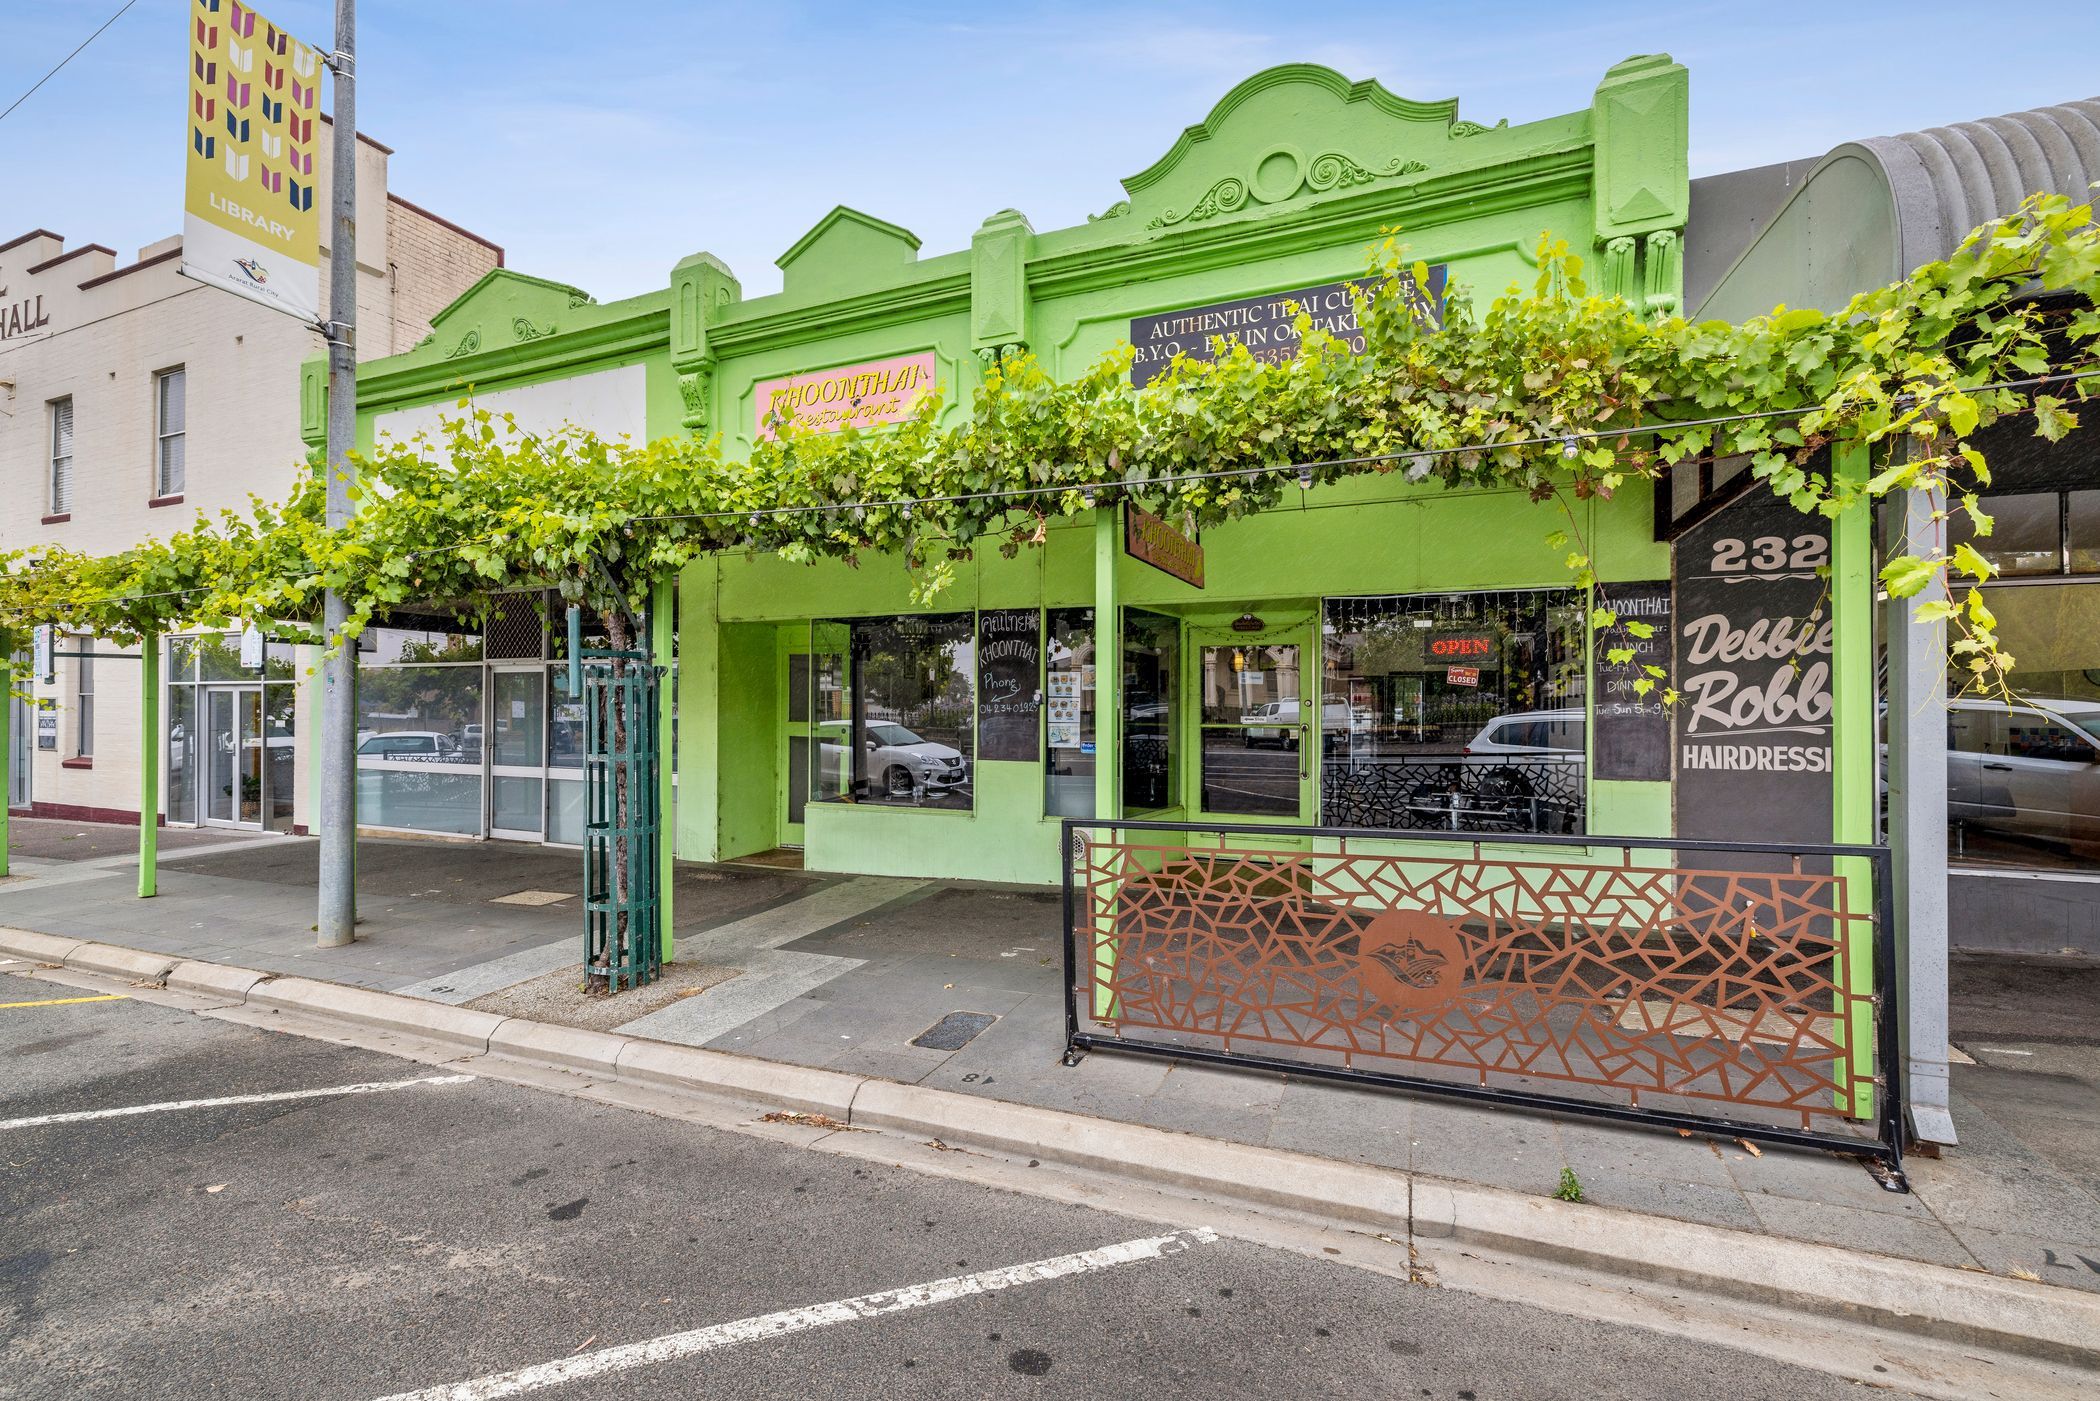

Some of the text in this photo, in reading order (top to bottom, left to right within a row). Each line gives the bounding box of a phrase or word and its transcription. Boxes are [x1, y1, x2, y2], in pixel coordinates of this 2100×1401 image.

[209, 191, 295, 241] LIBRARY
[228, 274, 280, 298] Ararat Rural City
[1150, 305, 1263, 340] AUTHENTIC
[1245, 326, 1268, 347] IN
[794, 398, 901, 427] Restaurant
[1711, 534, 1829, 572] 232
[978, 639, 1040, 668] KHOONTHAI
[1432, 638, 1489, 655] OPEN
[1683, 613, 1833, 665] Debbie
[983, 671, 1018, 692] Phone
[1448, 675, 1477, 684] CLOSED
[1683, 661, 1834, 733] Robb
